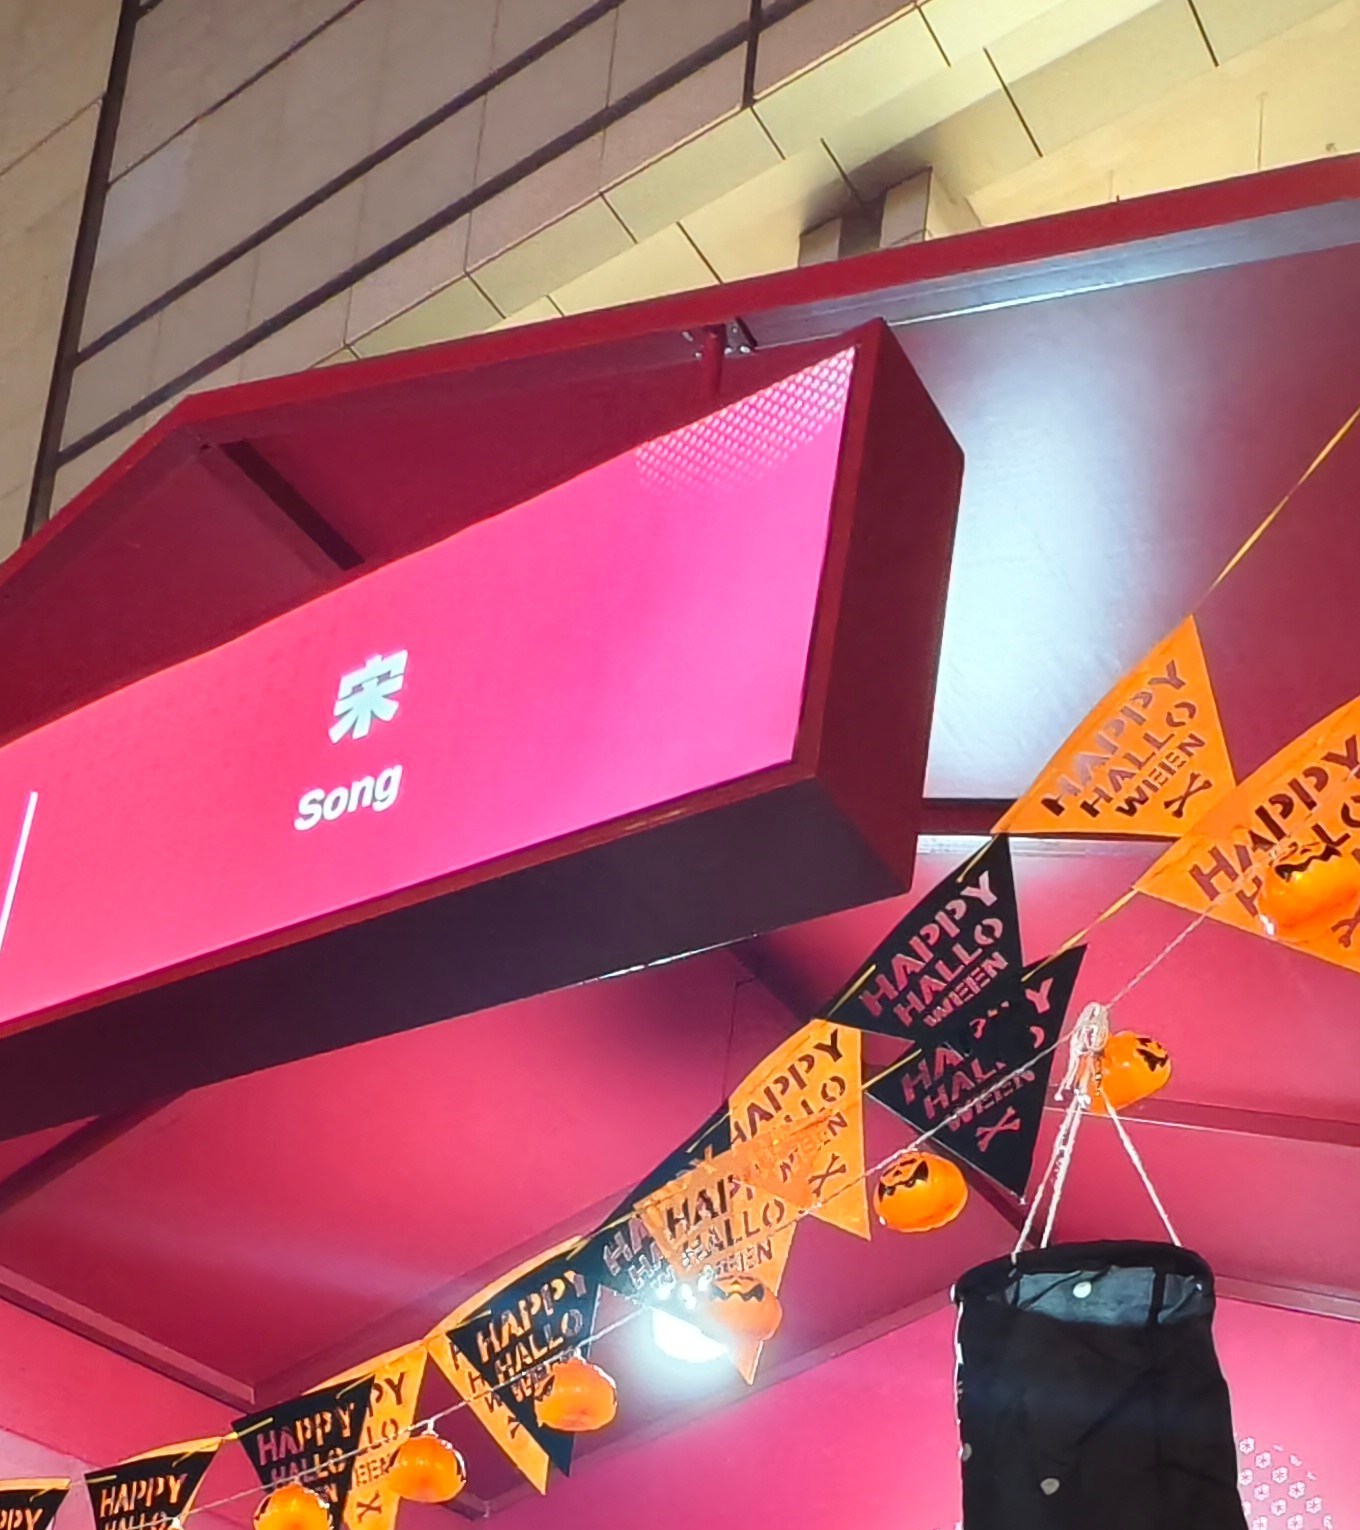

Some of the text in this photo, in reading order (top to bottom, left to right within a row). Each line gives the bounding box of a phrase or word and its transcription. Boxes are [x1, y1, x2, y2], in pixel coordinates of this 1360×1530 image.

[328, 650, 408, 744] 宋
[1040, 660, 1186, 816] HAPPY
[294, 765, 403, 831] Song
[1080, 701, 1197, 818] HALLO
[1115, 733, 1206, 817] WEEN
[859, 870, 997, 1017] HAPPY
[893, 917, 1003, 1027] HALLO
[924, 952, 1009, 1028] WEEN
[901, 977, 1054, 1106] HAY
[477, 1270, 587, 1364] HAPPY
[496, 1309, 583, 1385] HALLO
[256, 1402, 355, 1466] HAPPY
[101, 1474, 188, 1518] HAPPY
